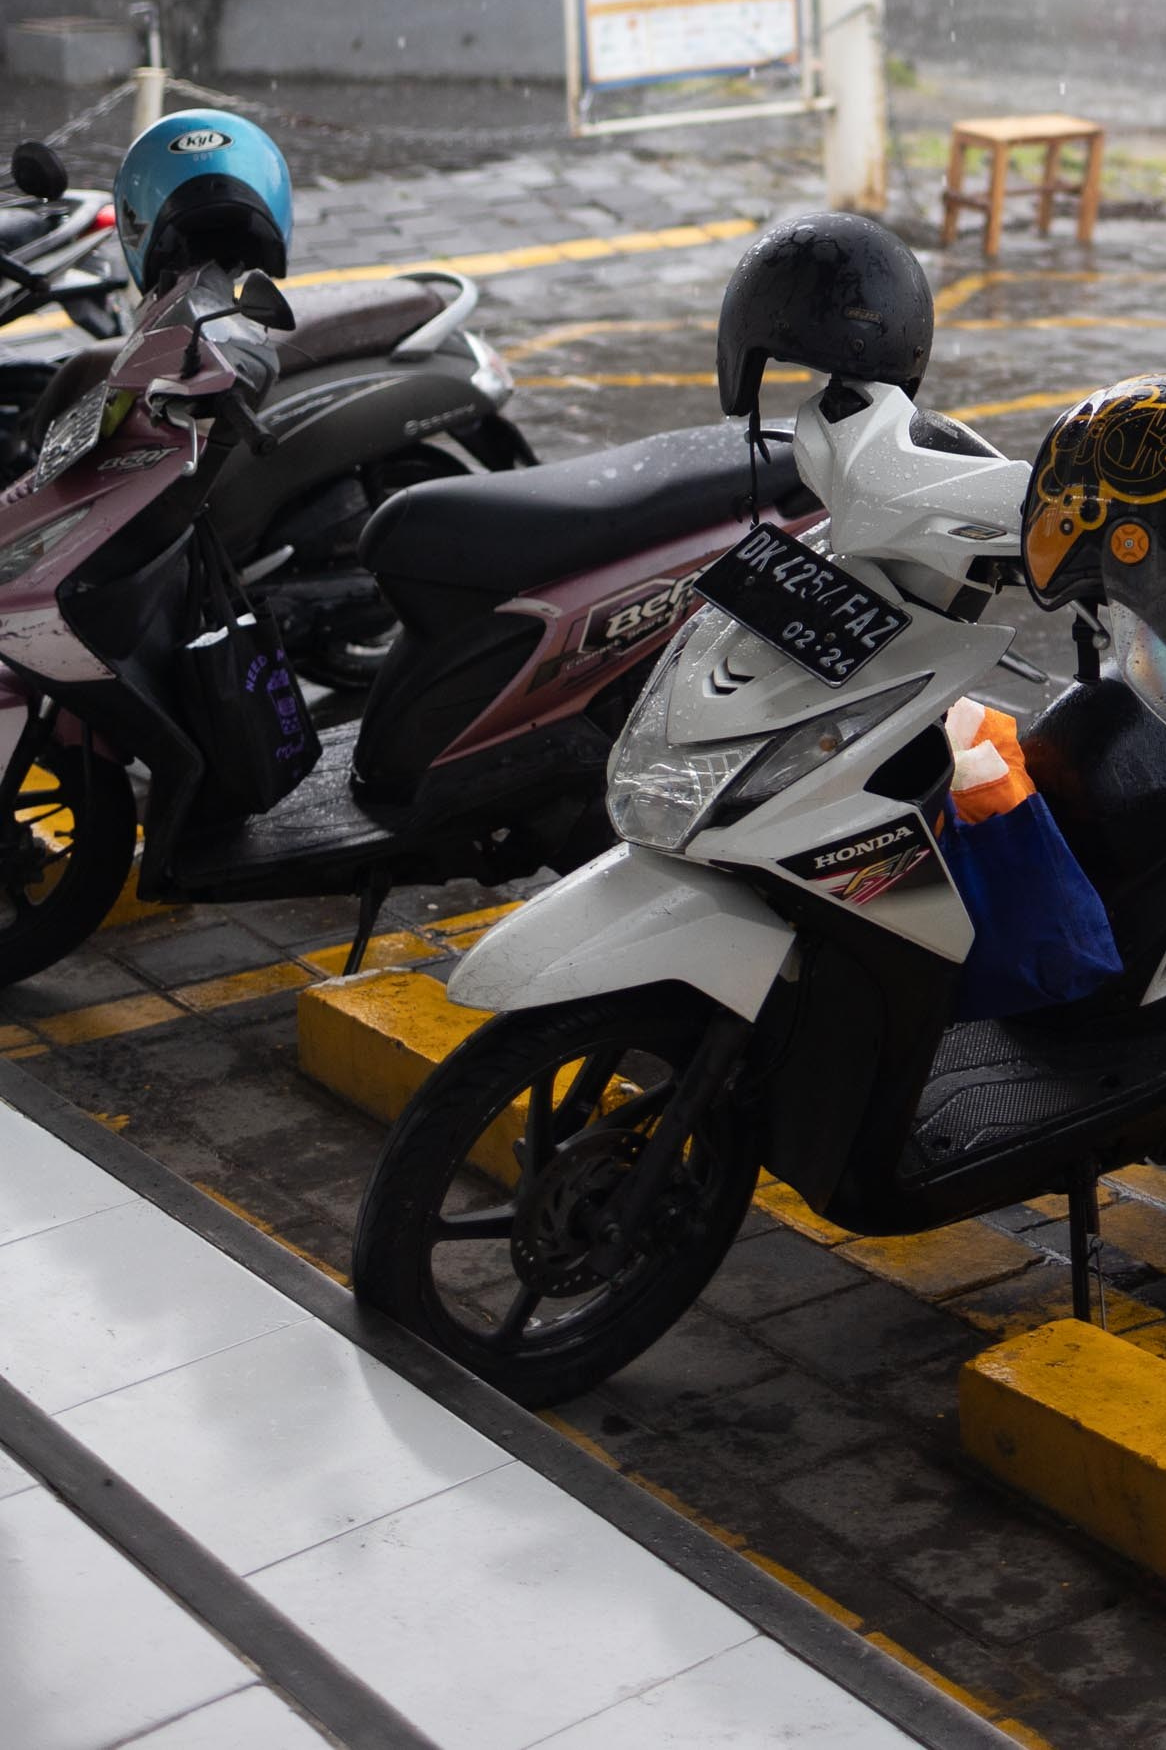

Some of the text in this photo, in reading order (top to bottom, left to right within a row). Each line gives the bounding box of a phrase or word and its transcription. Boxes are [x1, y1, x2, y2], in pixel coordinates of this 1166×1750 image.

[736, 531, 788, 573] DK
[831, 594, 900, 649] FAZ
[814, 826, 914, 870] HONDA
